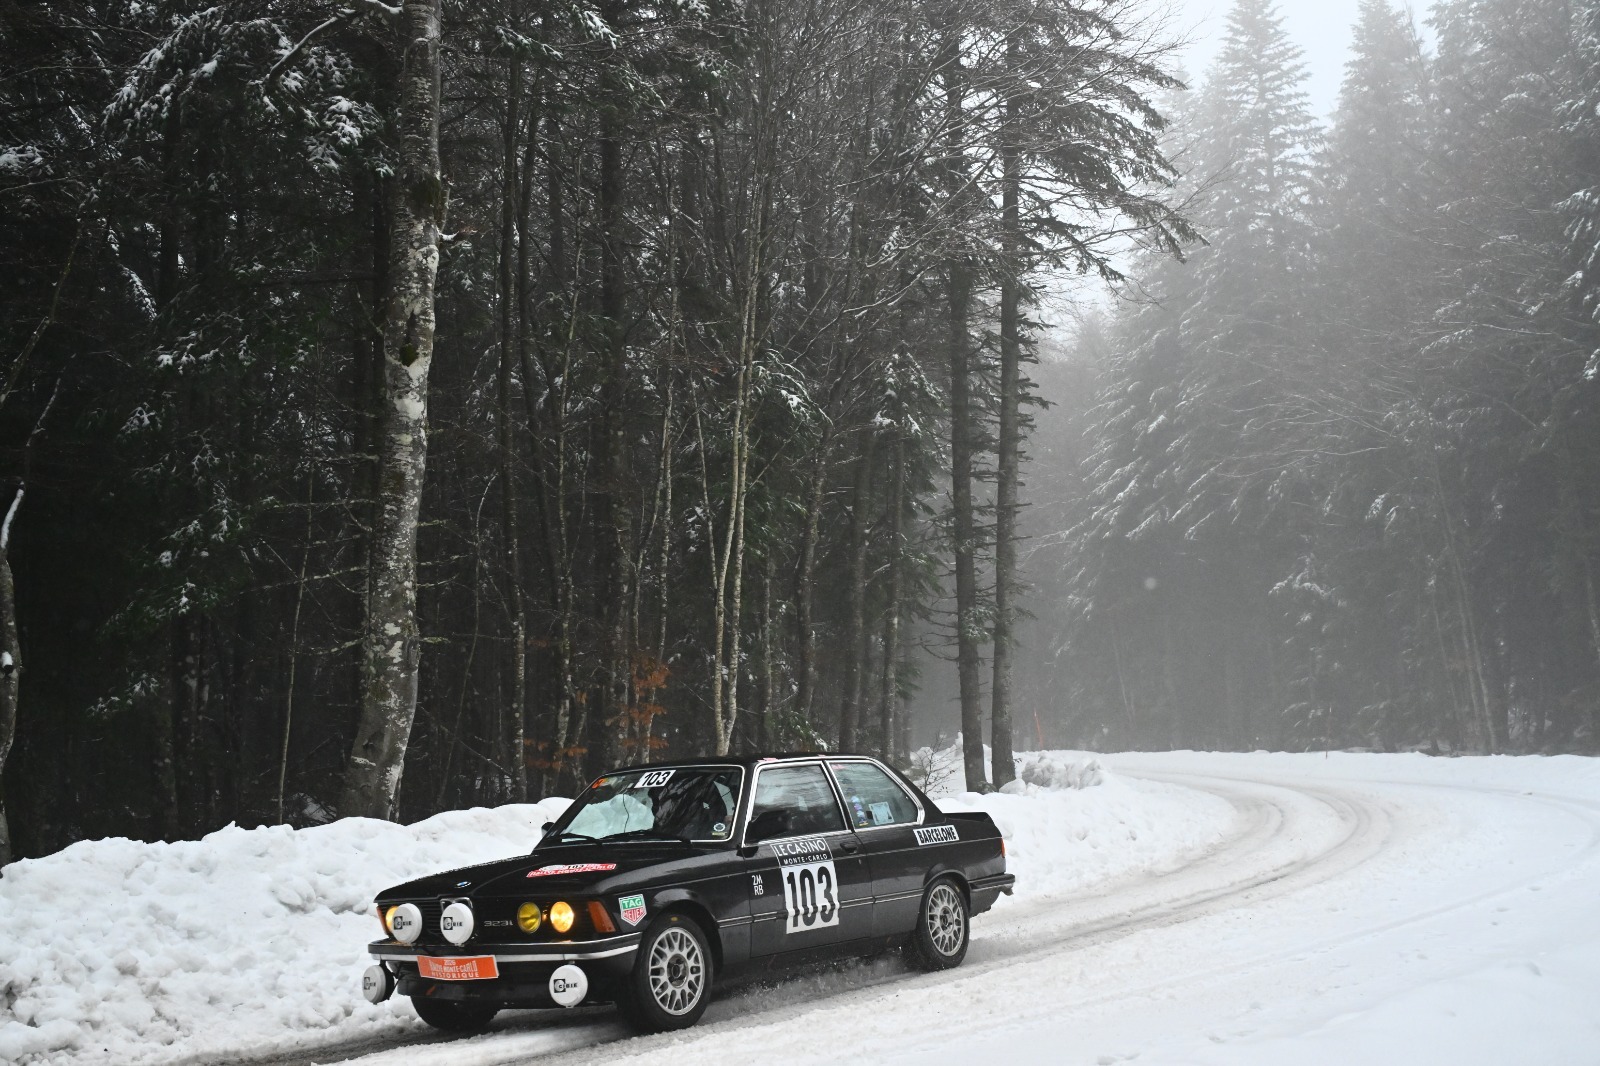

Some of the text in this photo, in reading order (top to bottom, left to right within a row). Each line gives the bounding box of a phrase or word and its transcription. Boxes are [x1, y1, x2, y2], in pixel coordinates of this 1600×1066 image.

[642, 771, 671, 787] 103
[916, 826, 957, 844] BARCELONE
[774, 839, 826, 857] LE CASINO
[751, 874, 763, 886] 2M
[753, 884, 764, 896] RB
[787, 866, 836, 928] 103
[622, 898, 642, 909] TAG
[431, 971, 480, 979] HISTORIQUE
